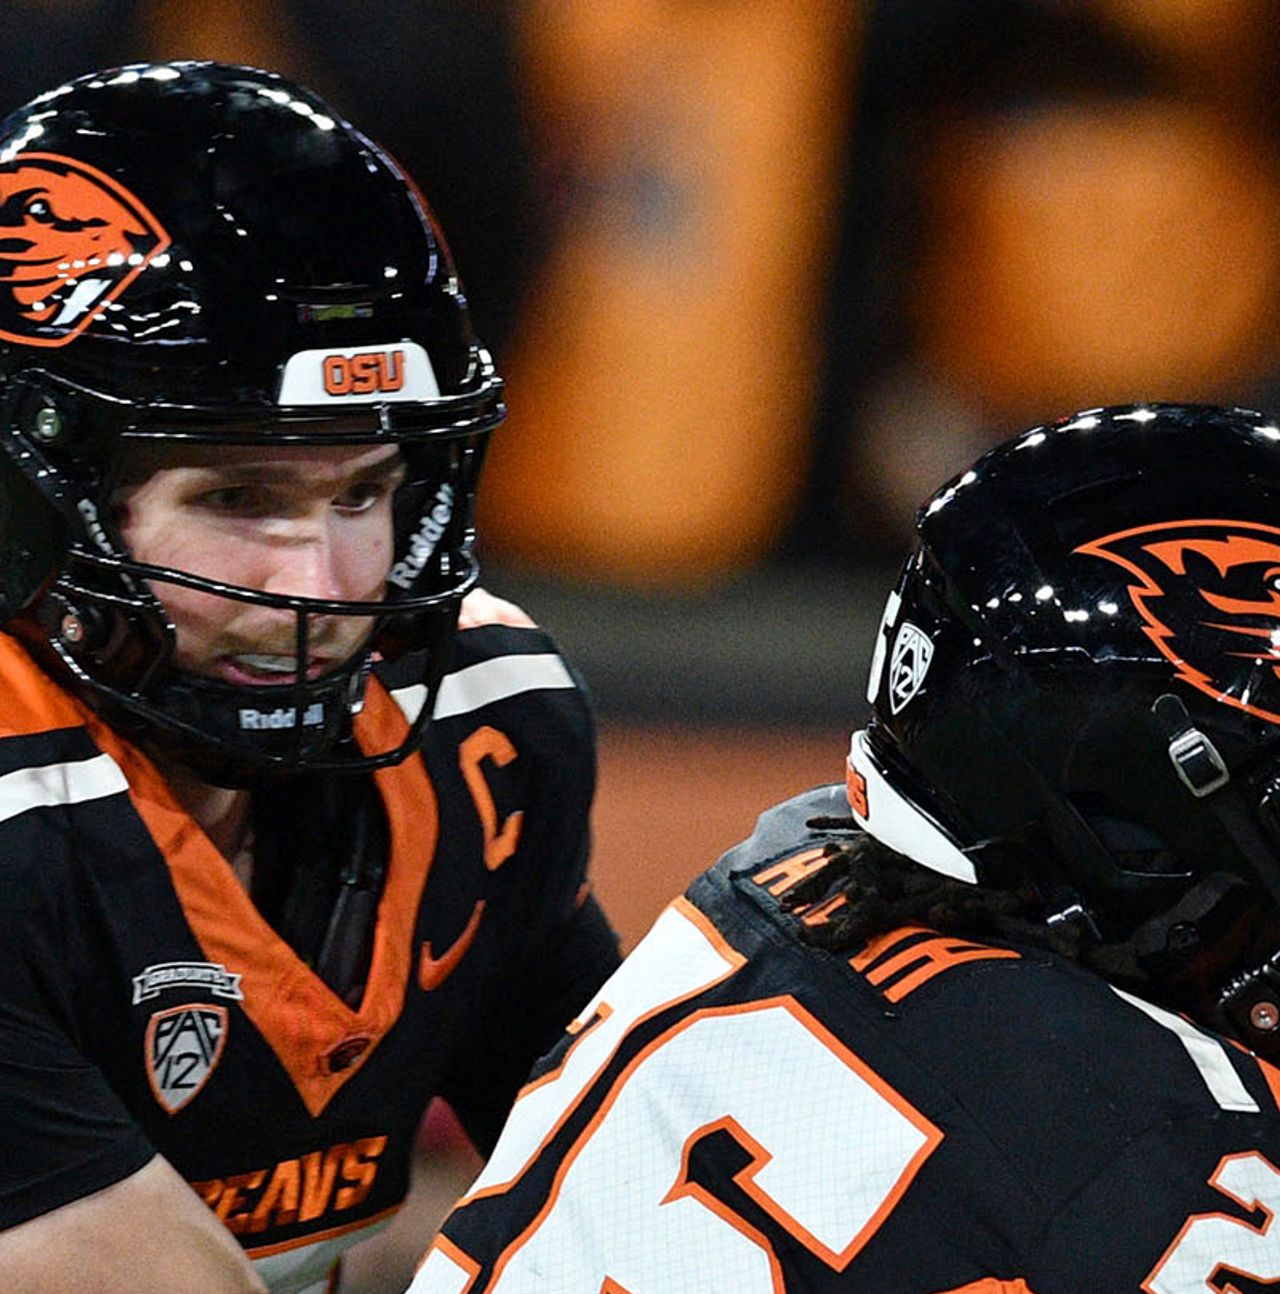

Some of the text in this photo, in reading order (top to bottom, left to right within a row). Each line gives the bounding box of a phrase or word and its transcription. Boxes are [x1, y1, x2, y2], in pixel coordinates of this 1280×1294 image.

[322, 350, 405, 396] OSU
[238, 702, 325, 730] Riddll
[458, 725, 524, 871] C
[154, 1010, 223, 1070] PAC
[161, 1052, 200, 1090] 12
